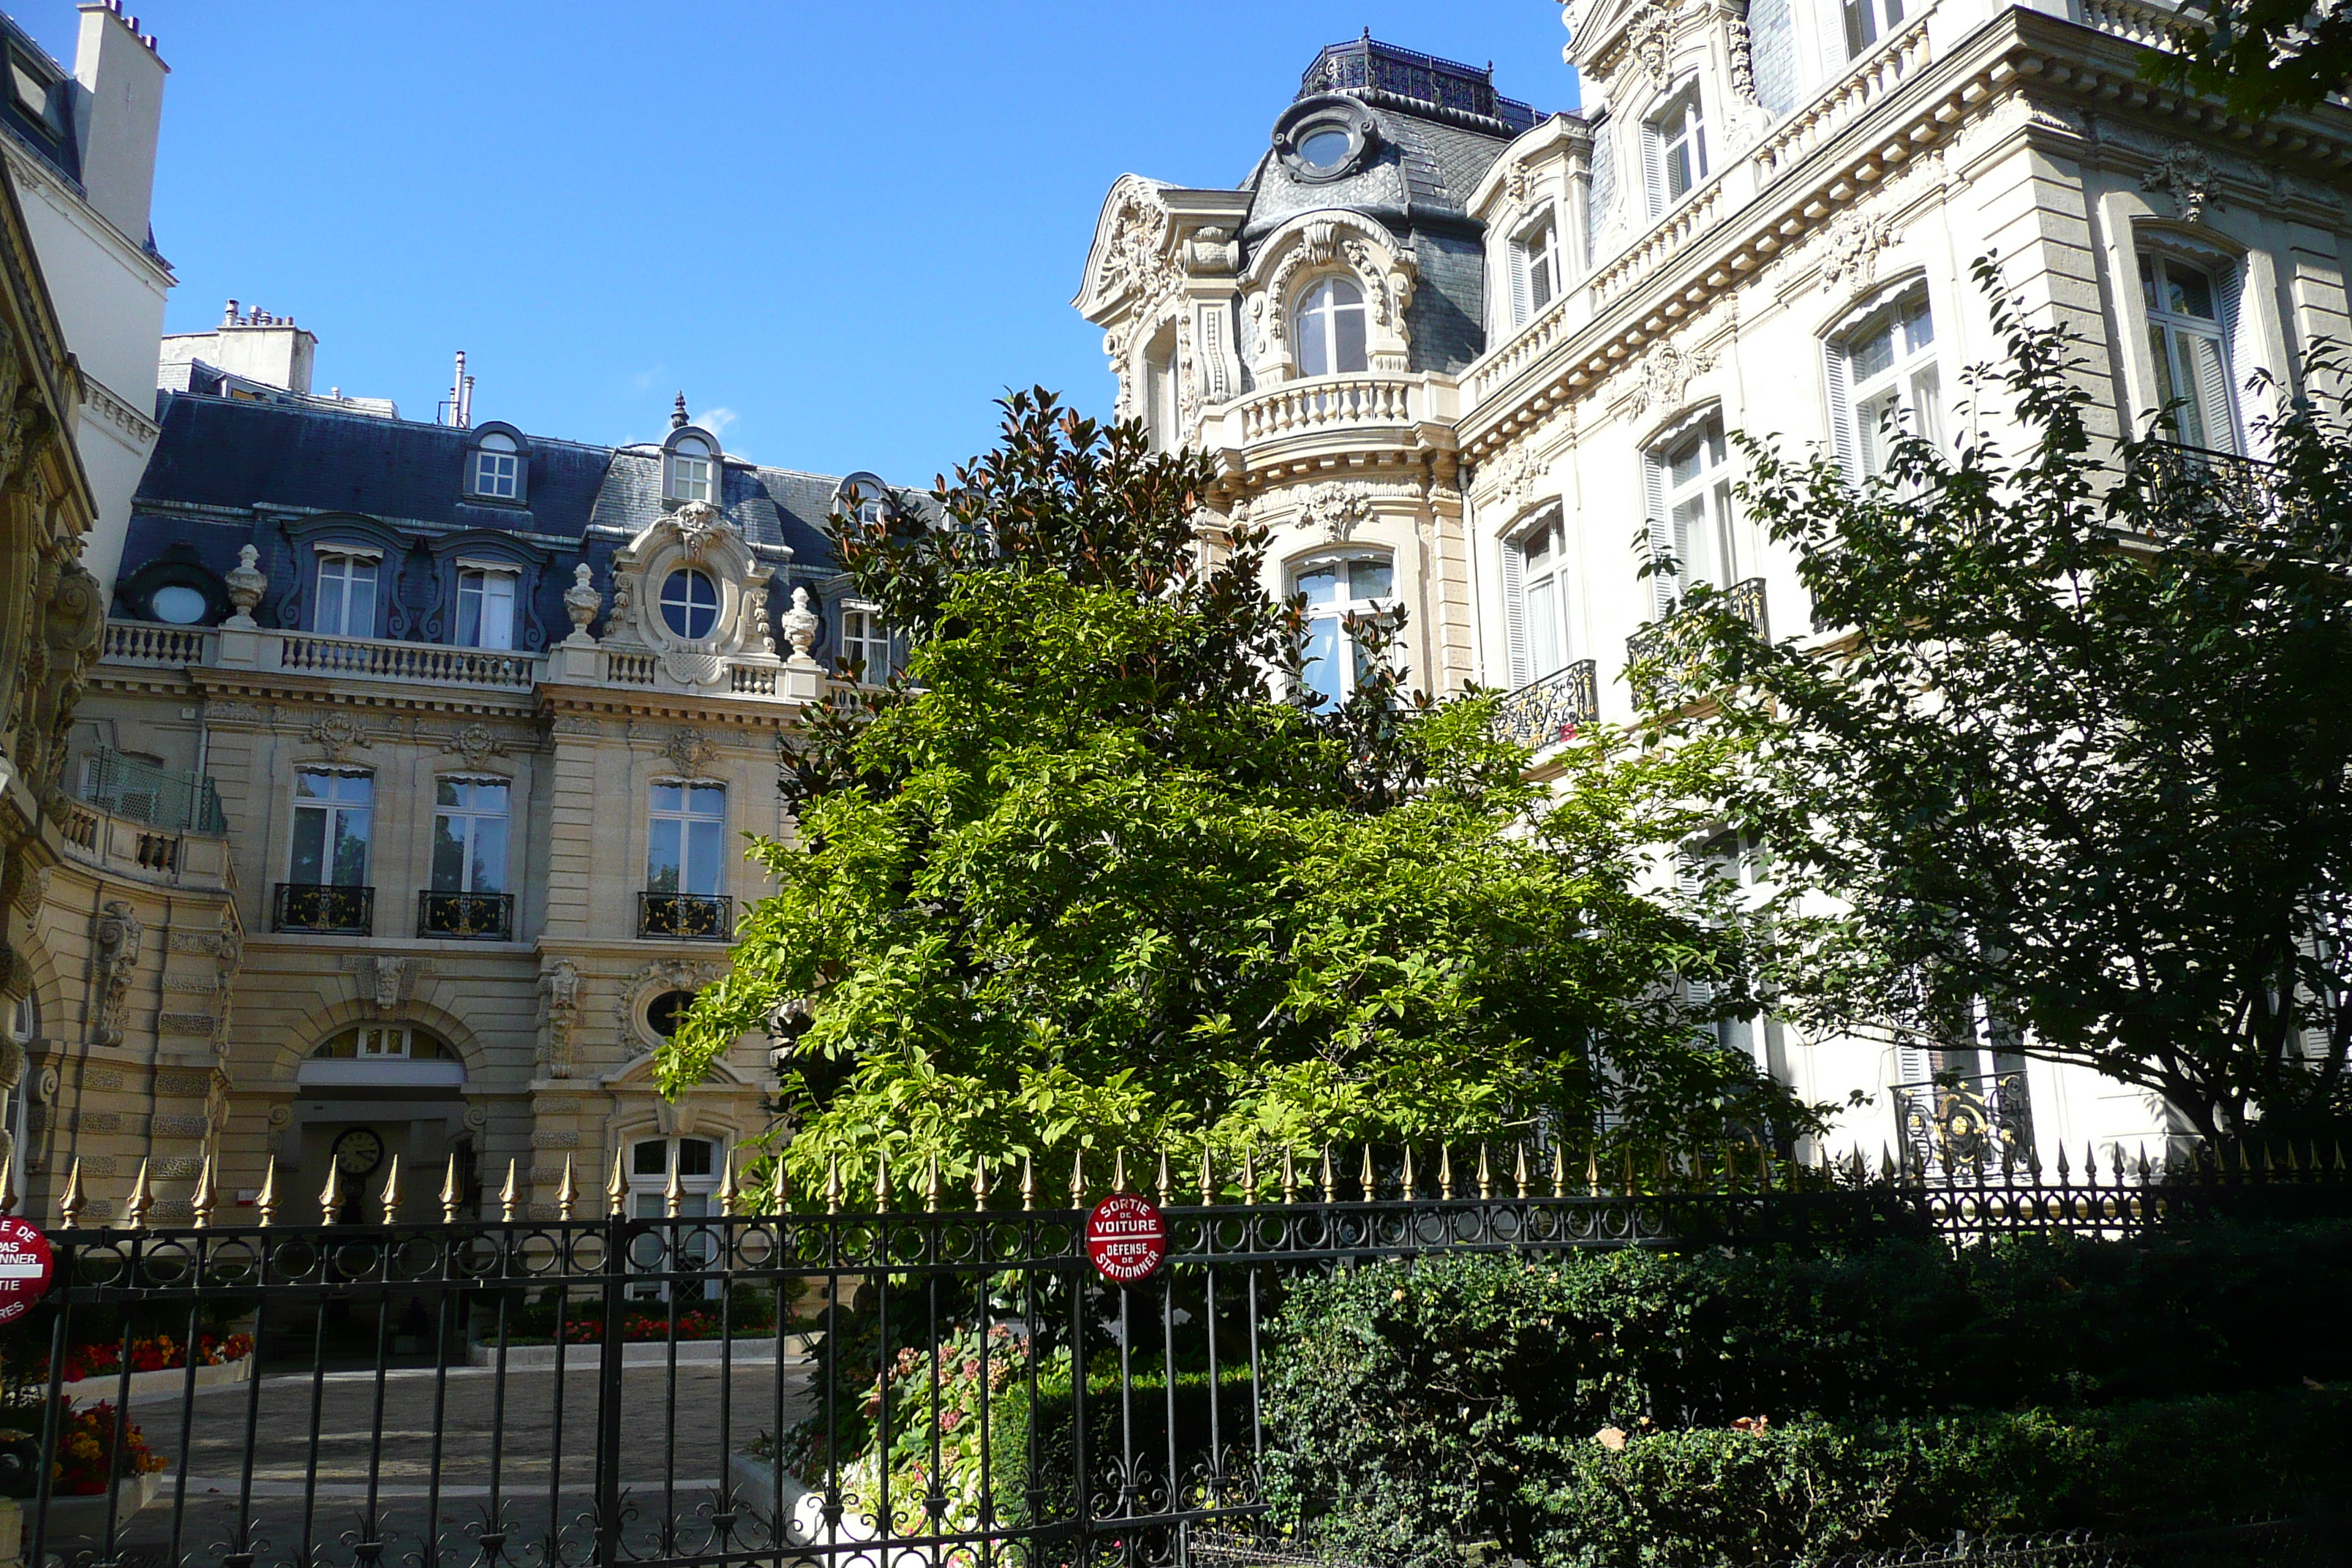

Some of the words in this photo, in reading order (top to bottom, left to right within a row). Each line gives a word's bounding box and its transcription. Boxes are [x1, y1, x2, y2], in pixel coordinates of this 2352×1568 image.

[1101, 1199, 1150, 1218] SORTIE
[16, 1226, 37, 1243] DE
[1095, 1219, 1157, 1233] VOITURE
[0, 1242, 20, 1252] AS
[1096, 1250, 1159, 1278] STATIONNER
